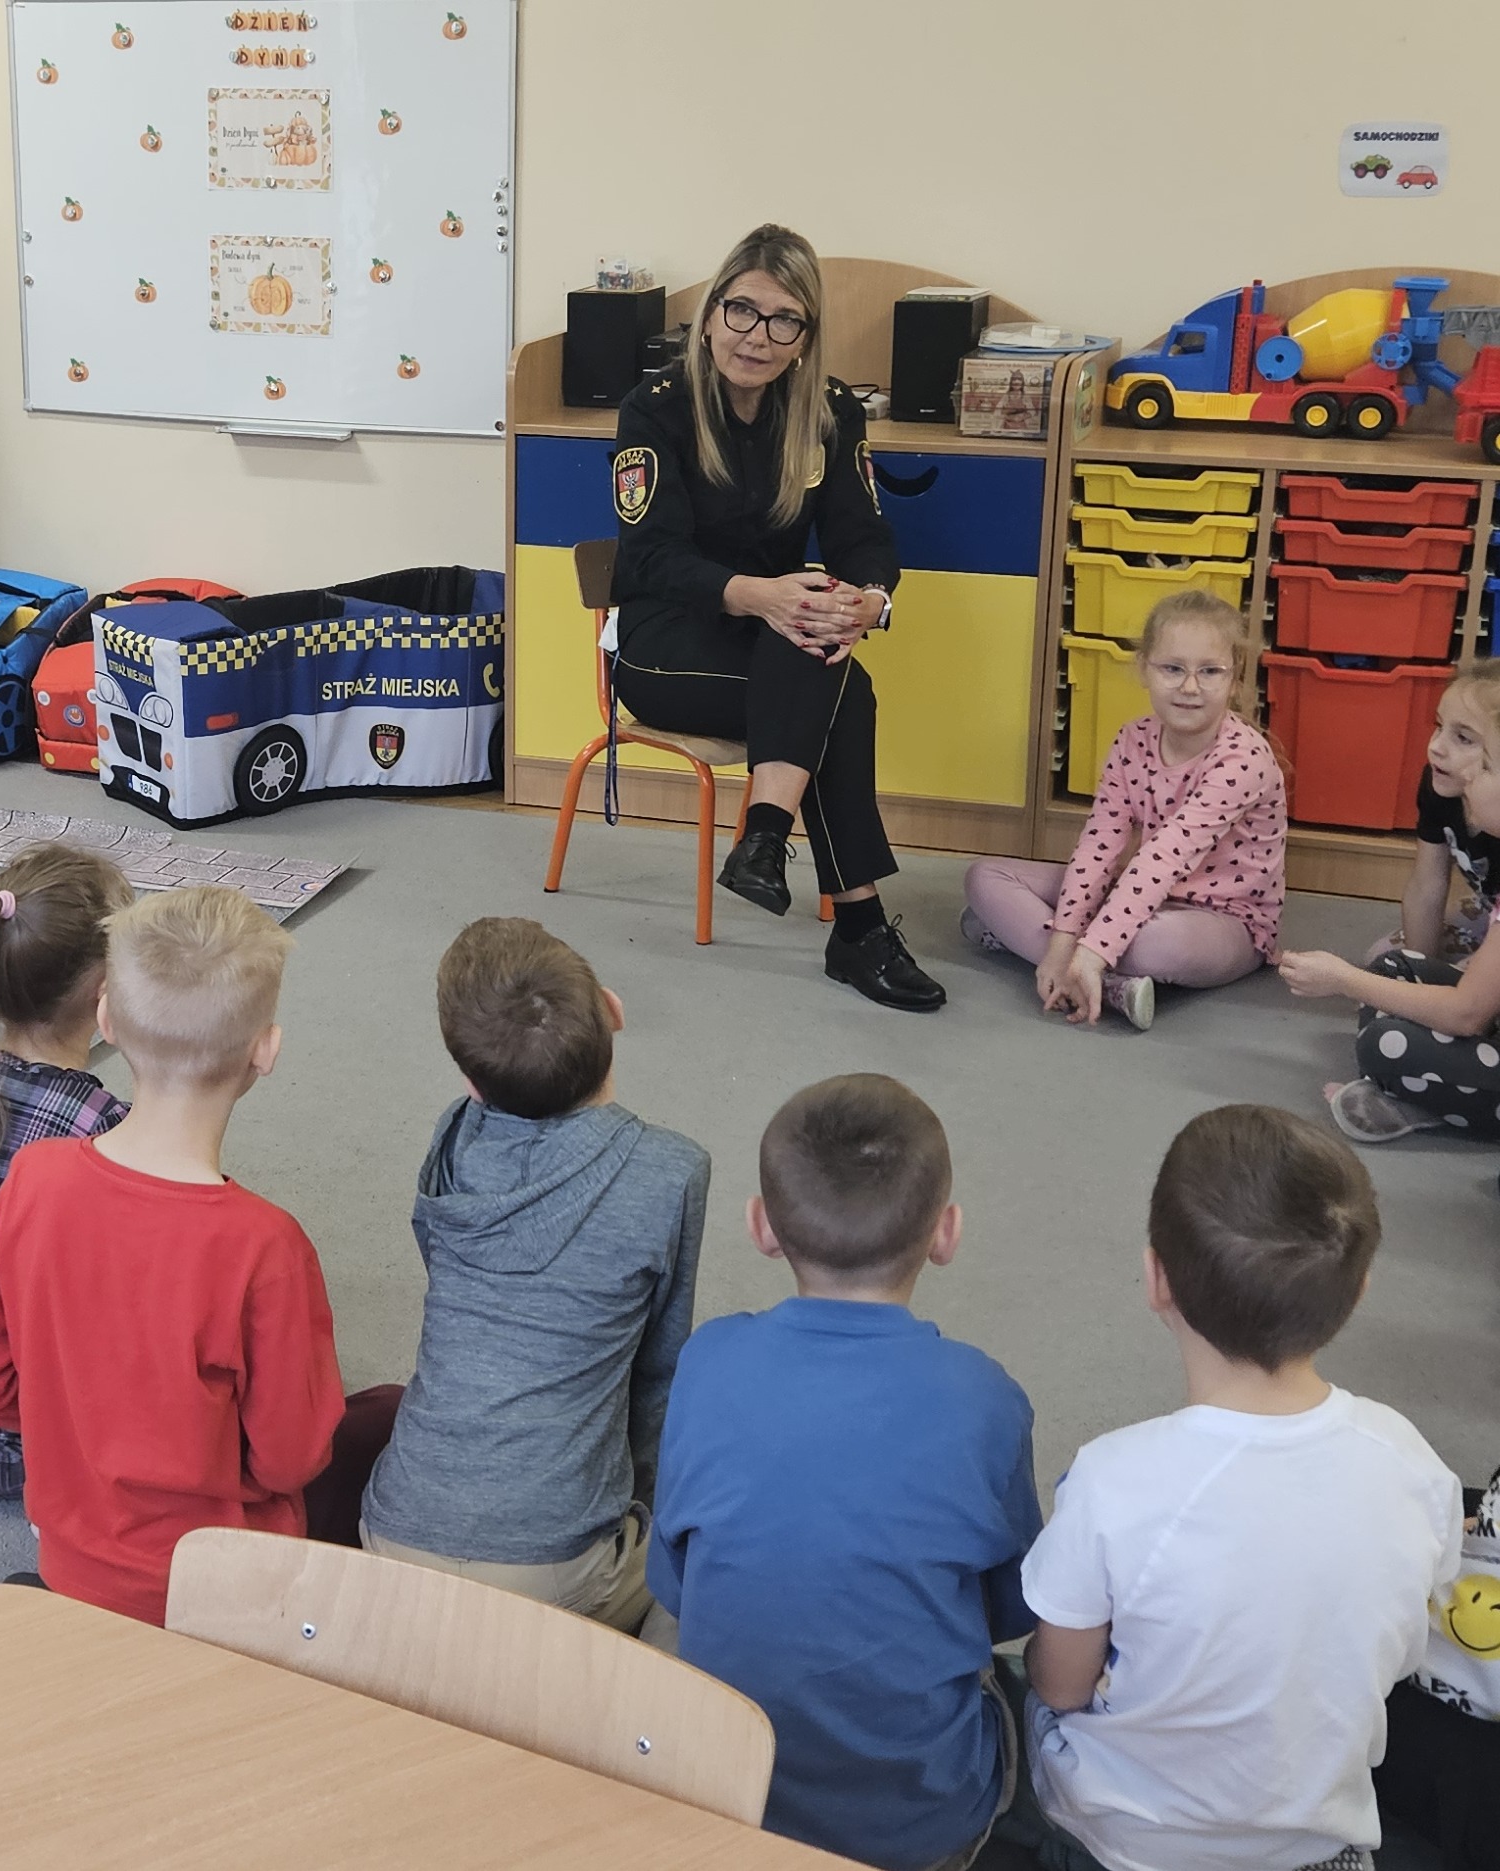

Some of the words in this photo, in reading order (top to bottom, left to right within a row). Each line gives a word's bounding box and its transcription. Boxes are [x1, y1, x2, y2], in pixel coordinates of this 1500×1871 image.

[238, 50, 300, 66] DYNI
[1353, 131, 1440, 142] SAMOCHODZIKI
[108, 658, 127, 677] STRAŻ
[127, 666, 154, 688] MIEJSKA
[322, 672, 377, 701] STRAŻ
[381, 677, 460, 698] MIEJSKA
[140, 782, 153, 795] 986
